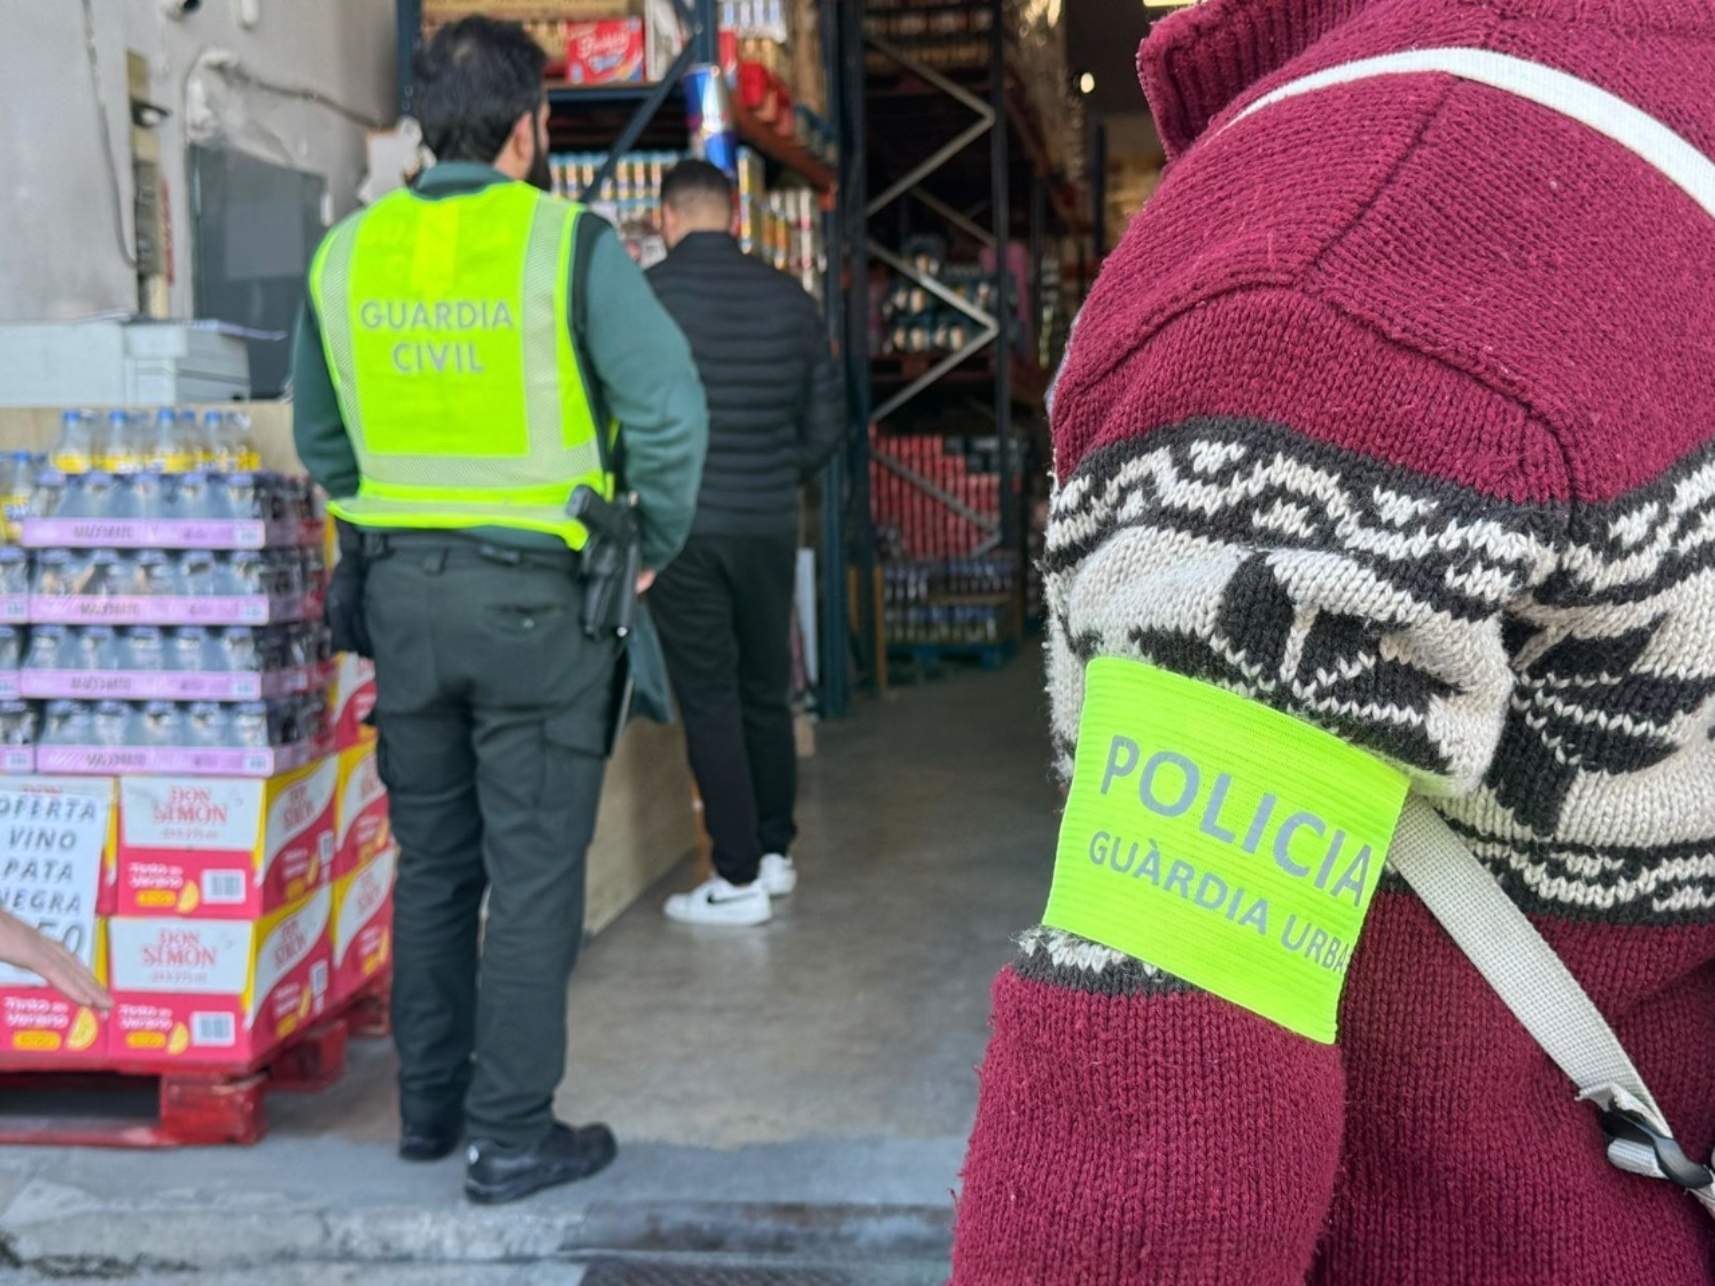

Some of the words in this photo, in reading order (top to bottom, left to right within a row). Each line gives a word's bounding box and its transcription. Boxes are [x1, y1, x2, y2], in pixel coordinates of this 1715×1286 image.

[360, 301, 513, 330] GUARDIA
[392, 341, 485, 373] CIVIL
[0, 798, 97, 823] OFERTA
[1100, 735, 1372, 908] POLICIA
[8, 828, 77, 851] VINO
[3, 858, 73, 883] PATA
[1088, 831, 1268, 936] GUÀRDIA
